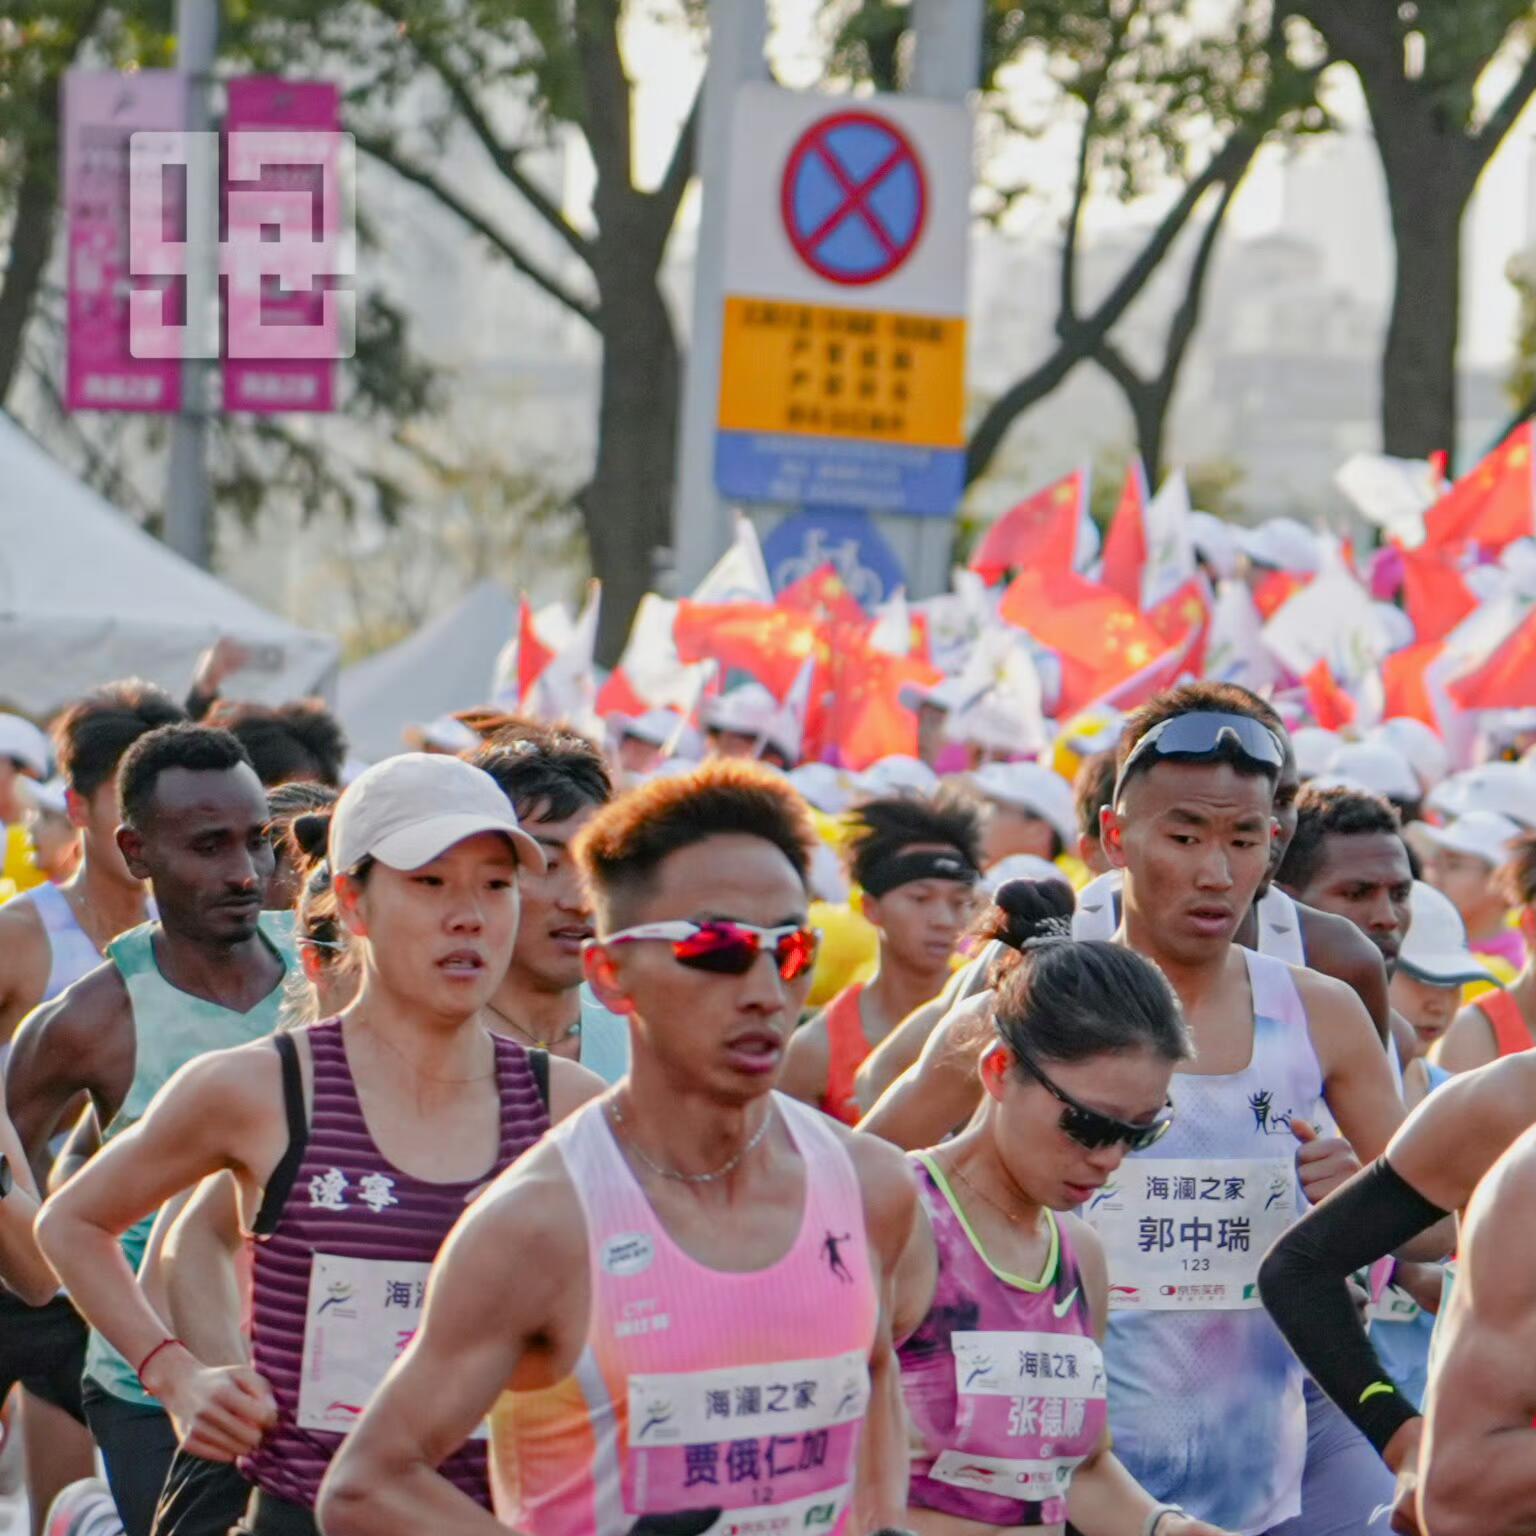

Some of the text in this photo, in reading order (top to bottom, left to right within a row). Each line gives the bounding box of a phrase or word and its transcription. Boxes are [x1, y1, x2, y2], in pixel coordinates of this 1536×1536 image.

[1146, 1176, 1246, 1201] 海澜之家
[1137, 1216, 1251, 1253] 郭中瑞
[1181, 1258, 1210, 1271] 123
[705, 1381, 818, 1419] 海澜之家
[684, 1430, 829, 1487] 贾俄仁加
[752, 1488, 772, 1502] 12
